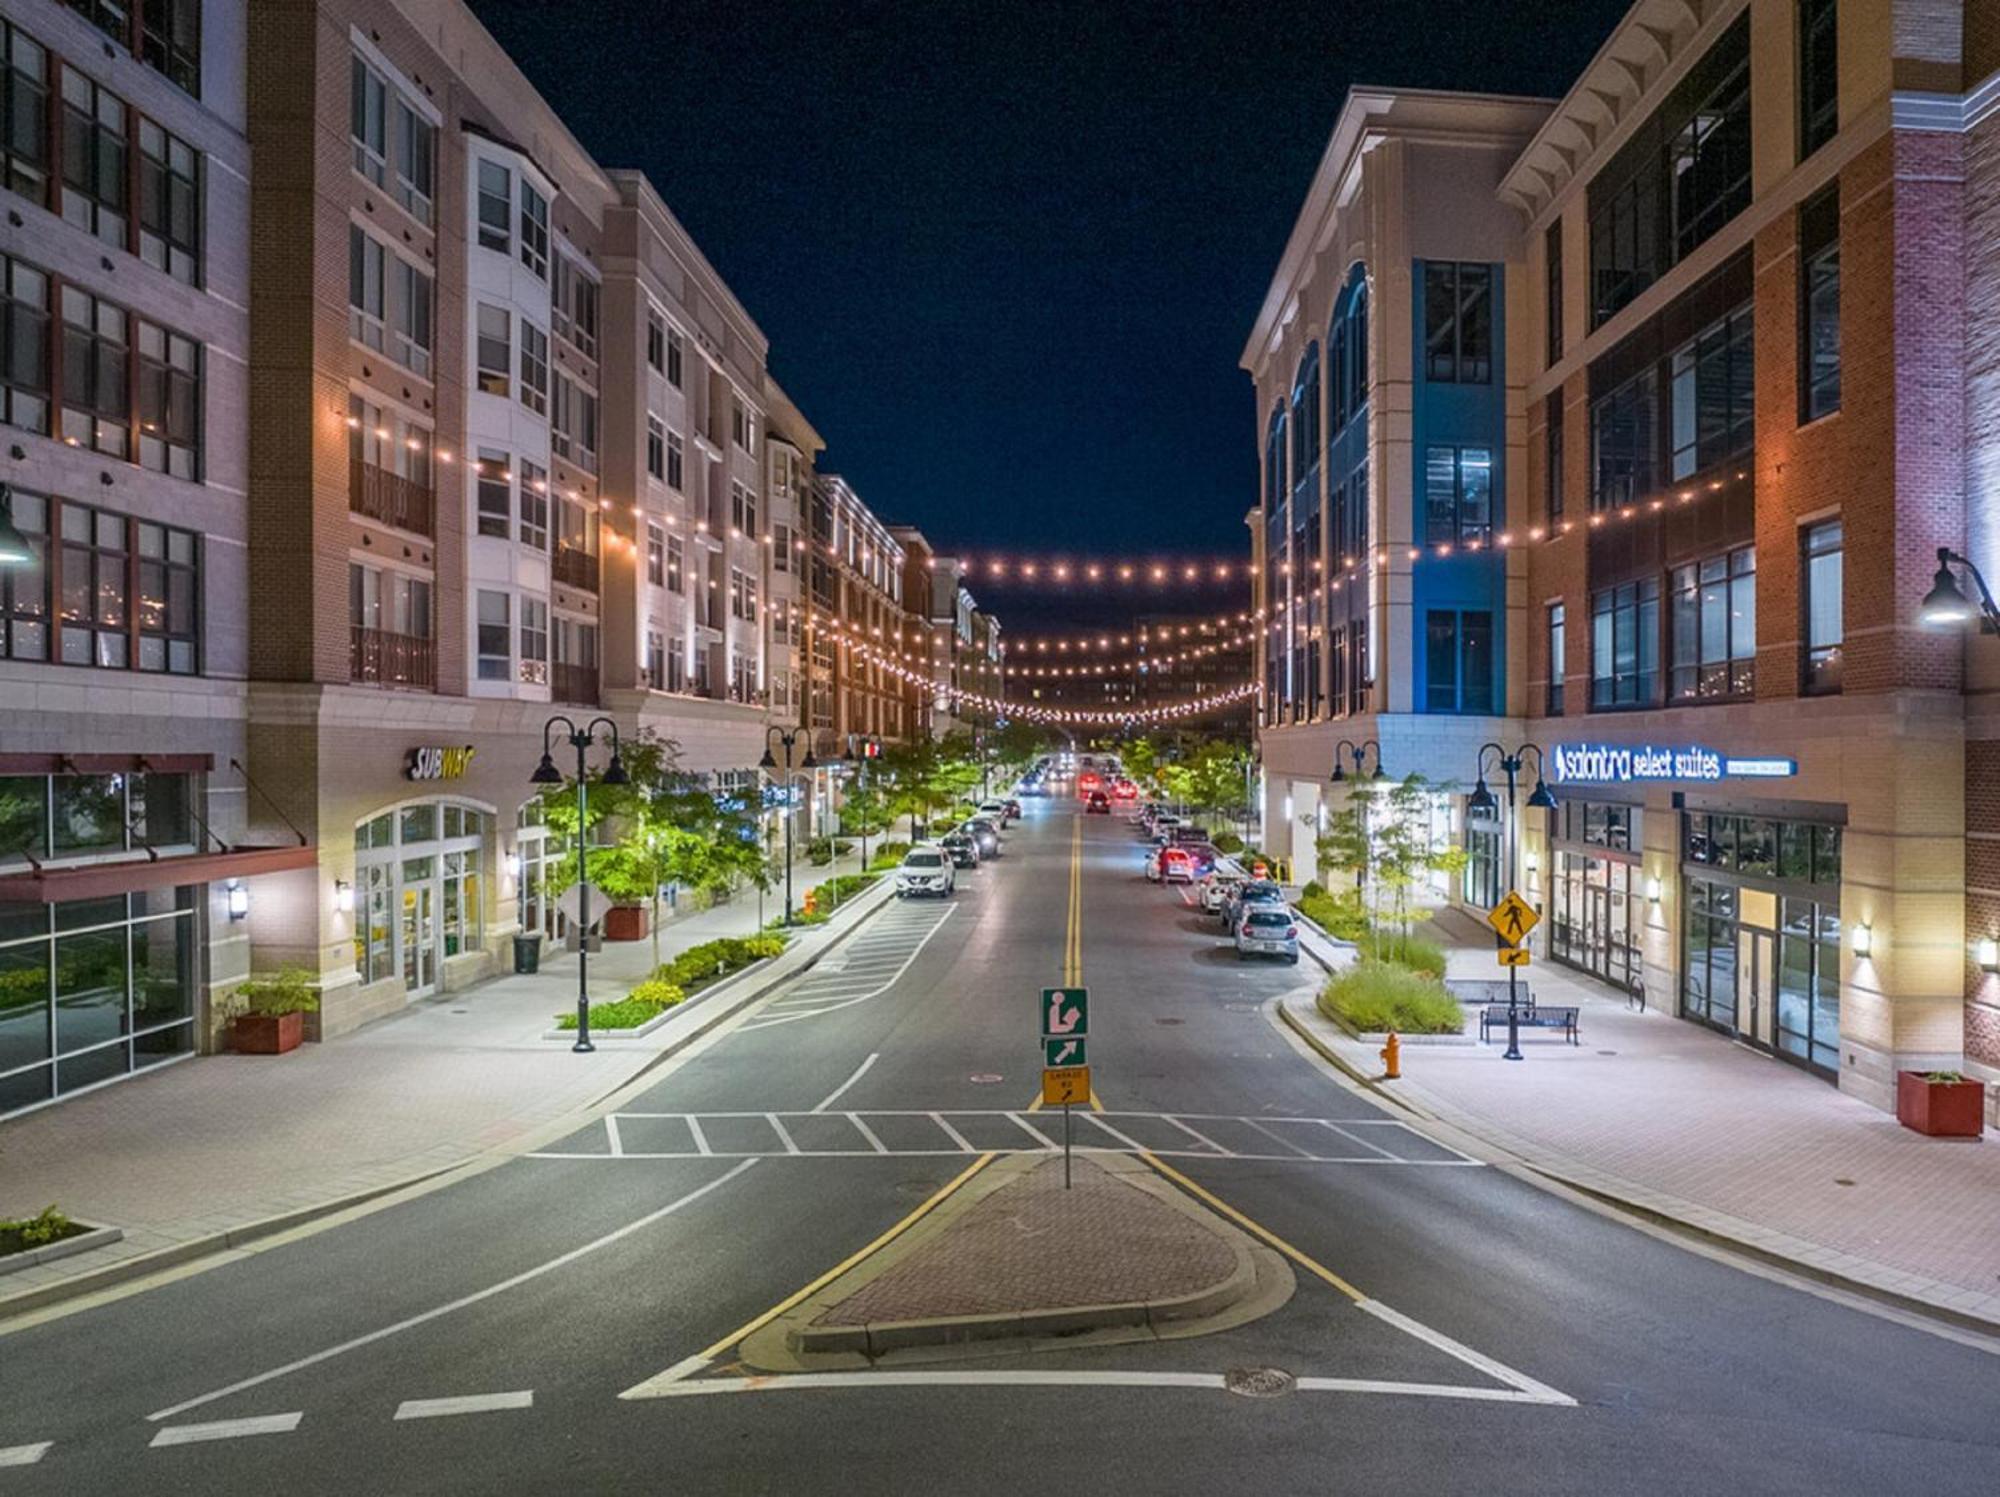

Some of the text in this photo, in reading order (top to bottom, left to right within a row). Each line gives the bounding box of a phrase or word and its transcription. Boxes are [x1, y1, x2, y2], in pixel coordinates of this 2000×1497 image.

[410, 746, 476, 780] SUBWAY
[1633, 746, 1672, 777] select
[1675, 747, 1720, 779] suites
